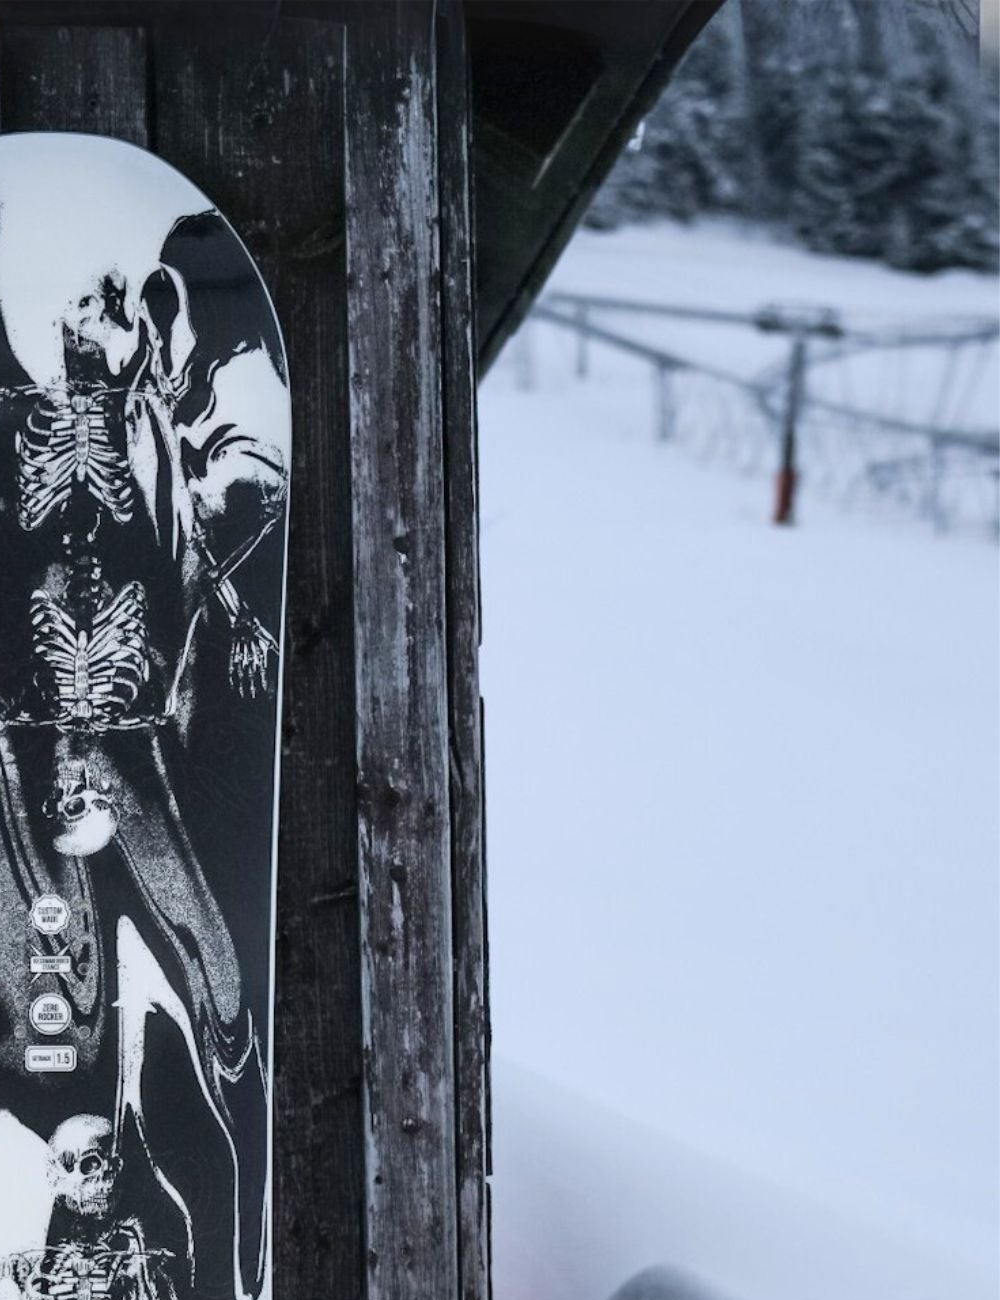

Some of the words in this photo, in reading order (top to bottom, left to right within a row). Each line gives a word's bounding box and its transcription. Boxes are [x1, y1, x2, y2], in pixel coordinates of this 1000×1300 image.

[43, 1003, 59, 1012] ZERO
[38, 1012, 64, 1021] ROCKER
[56, 1052, 70, 1064] 1.5
